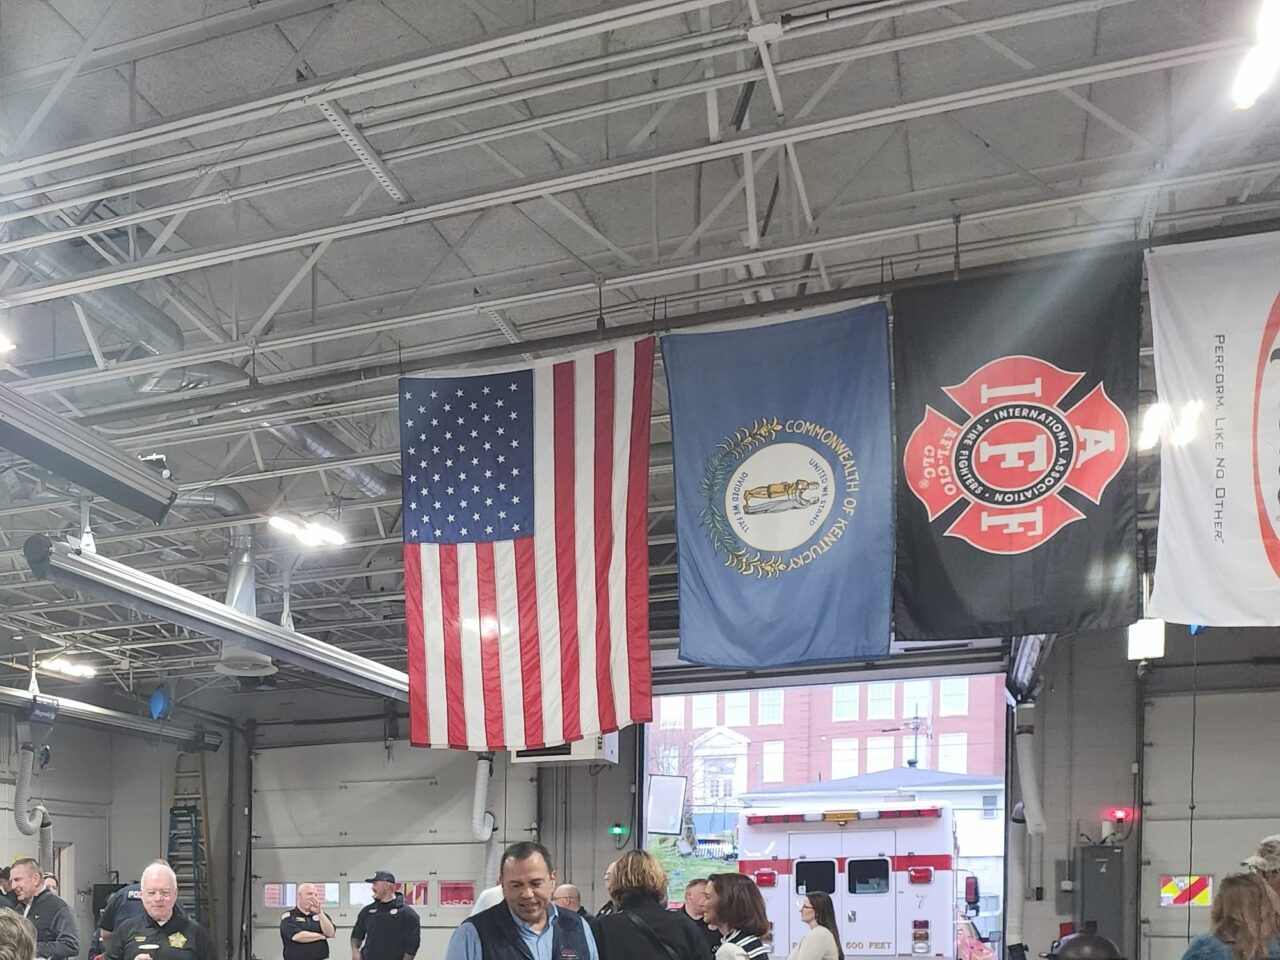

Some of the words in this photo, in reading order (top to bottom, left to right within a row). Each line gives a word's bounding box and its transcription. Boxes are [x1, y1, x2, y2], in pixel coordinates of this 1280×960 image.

[963, 424, 983, 446] FIRE
[993, 407, 1070, 454] INTERNATIONAL
[1214, 416, 1225, 450] LIKE
[785, 419, 859, 493] COMMONWEALTH
[936, 426, 958, 496] AFL-CIO
[979, 434, 1047, 472] F
[1075, 424, 1116, 469] A
[808, 457, 829, 485] UNITED
[958, 450, 984, 494] FIGHTERS
[994, 457, 1067, 502] ASSOCIATION
[1215, 456, 1225, 480] NO
[731, 471, 749, 502] DIVIDED
[820, 485, 829, 498] WE
[732, 502, 740, 516] WE
[808, 498, 827, 526] STAND
[843, 497, 857, 516] OF
[981, 505, 1043, 537] F
[736, 517, 749, 533] FALL
[786, 517, 849, 572] KENTUCKY
[869, 942, 892, 950] FEET
